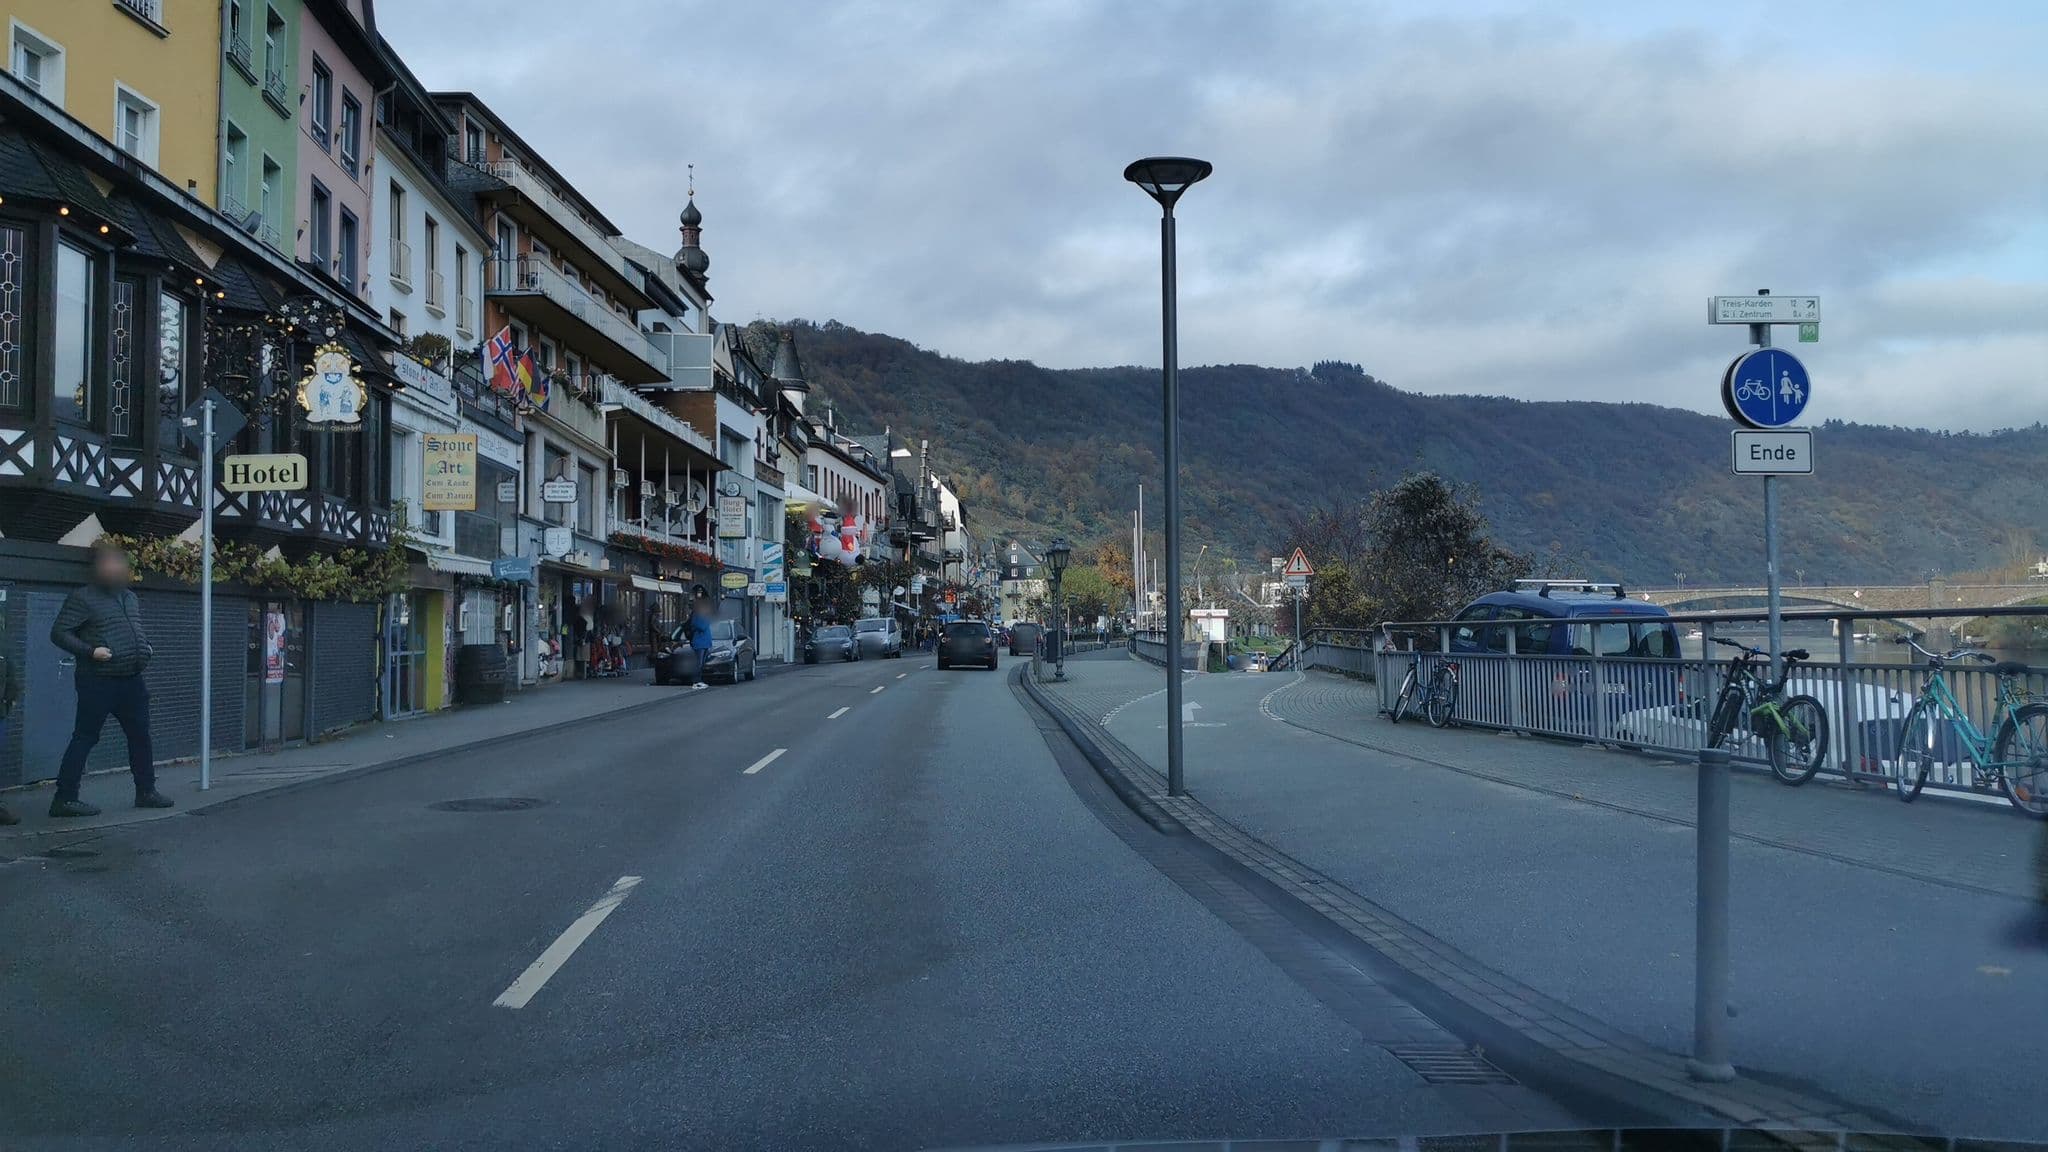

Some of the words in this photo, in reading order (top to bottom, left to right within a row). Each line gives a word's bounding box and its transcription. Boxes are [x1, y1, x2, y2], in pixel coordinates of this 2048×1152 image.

[1721, 299, 1773, 308] Treis-Karden
[1739, 310, 1772, 318] Zentrum
[426, 436, 473, 453] Stone
[1750, 444, 1796, 460] Ende
[231, 463, 299, 485] Hotel
[437, 459, 463, 475] Art
